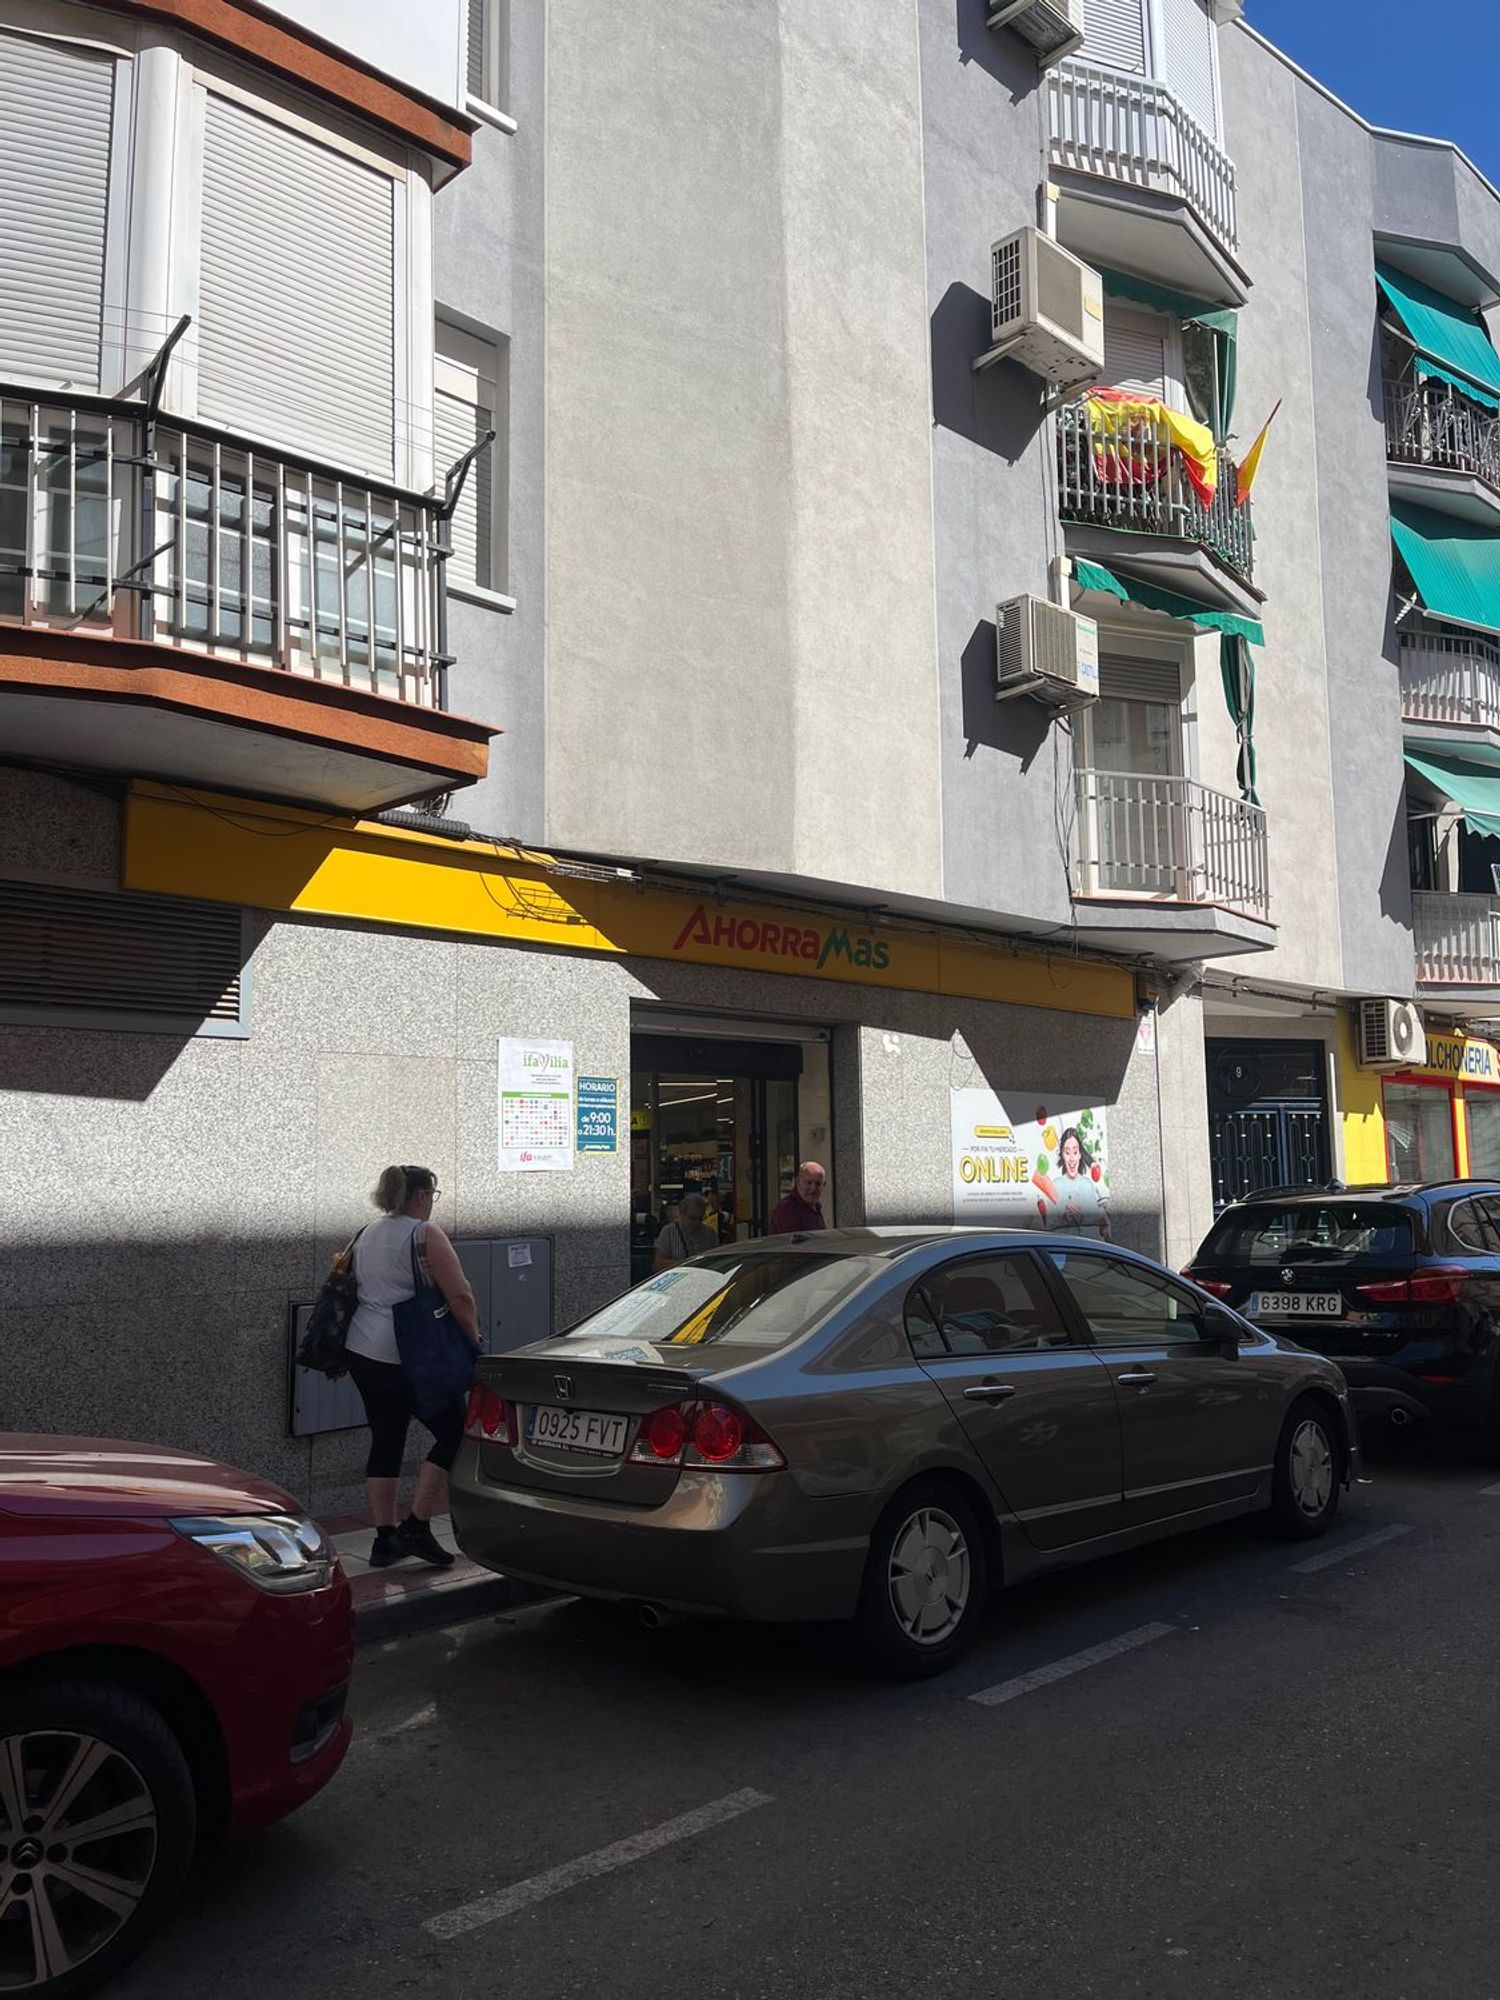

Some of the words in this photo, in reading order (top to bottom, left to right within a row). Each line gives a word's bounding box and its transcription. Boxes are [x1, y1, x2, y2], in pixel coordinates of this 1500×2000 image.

[1235, 1066, 1242, 1078] 9
[579, 1082, 616, 1092] HORARIO
[581, 1115, 590, 1123] de
[590, 1112, 611, 1124] 9:00
[583, 1124, 606, 1136] 21:30
[959, 1155, 1029, 1184] ONLINE
[1261, 1296, 1301, 1311] 6398
[1306, 1296, 1337, 1312] KRG
[538, 1411, 581, 1440] 0925
[585, 1415, 623, 1447] FVT
